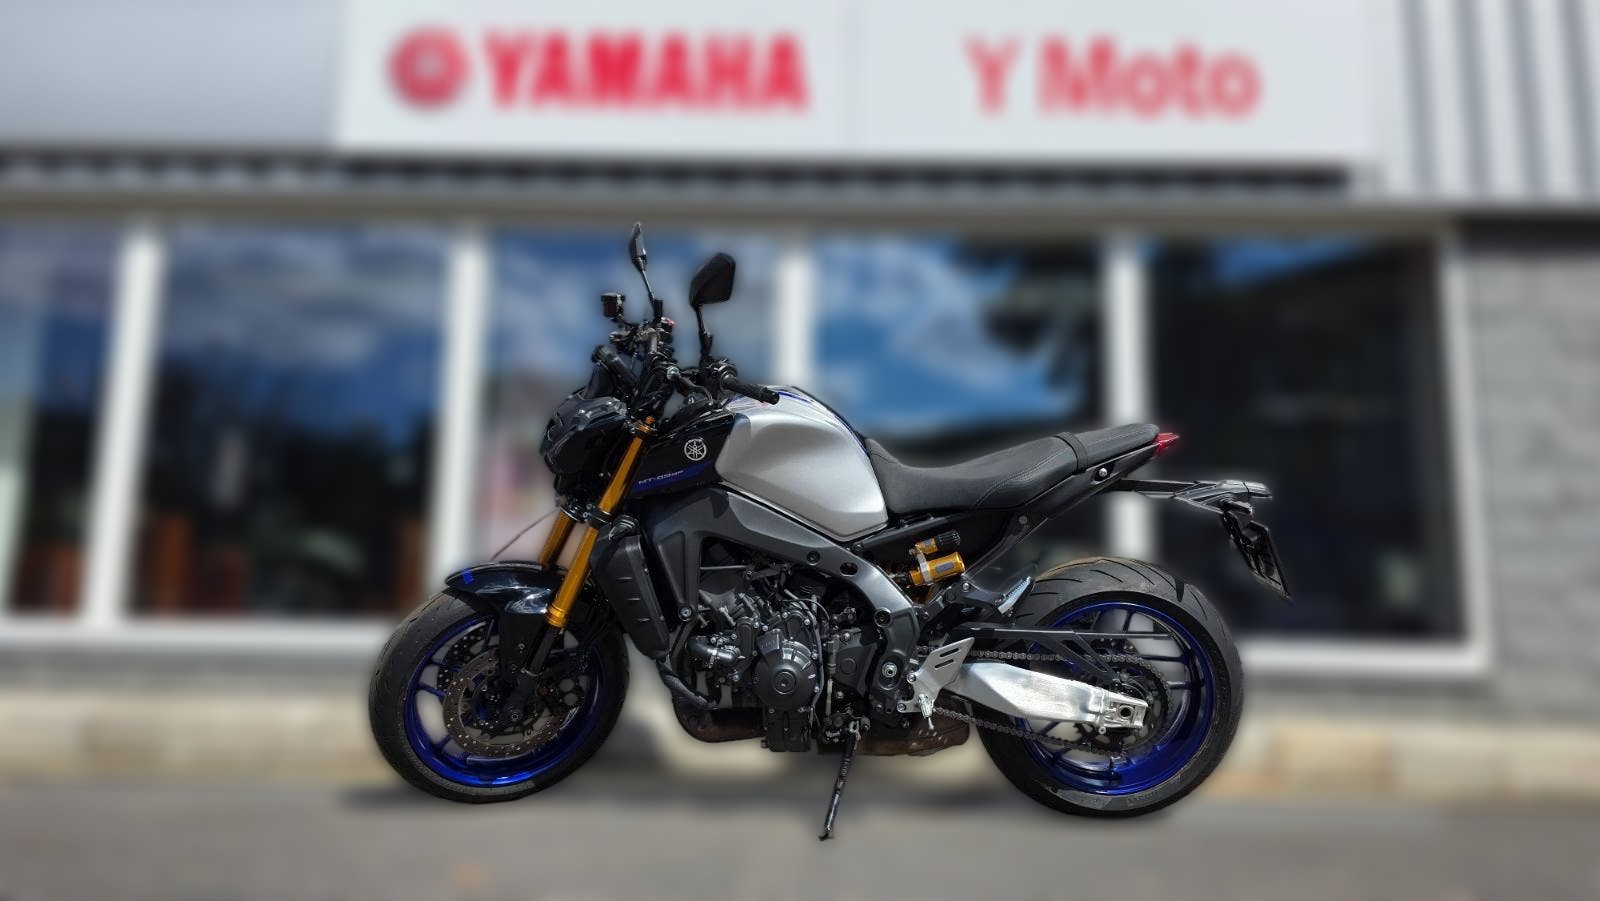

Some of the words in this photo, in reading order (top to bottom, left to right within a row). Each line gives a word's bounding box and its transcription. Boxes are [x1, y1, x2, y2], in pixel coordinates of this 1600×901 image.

[484, 31, 809, 111] YAMAHA
[964, 37, 1022, 115] Y
[1038, 37, 1261, 118] Moto
